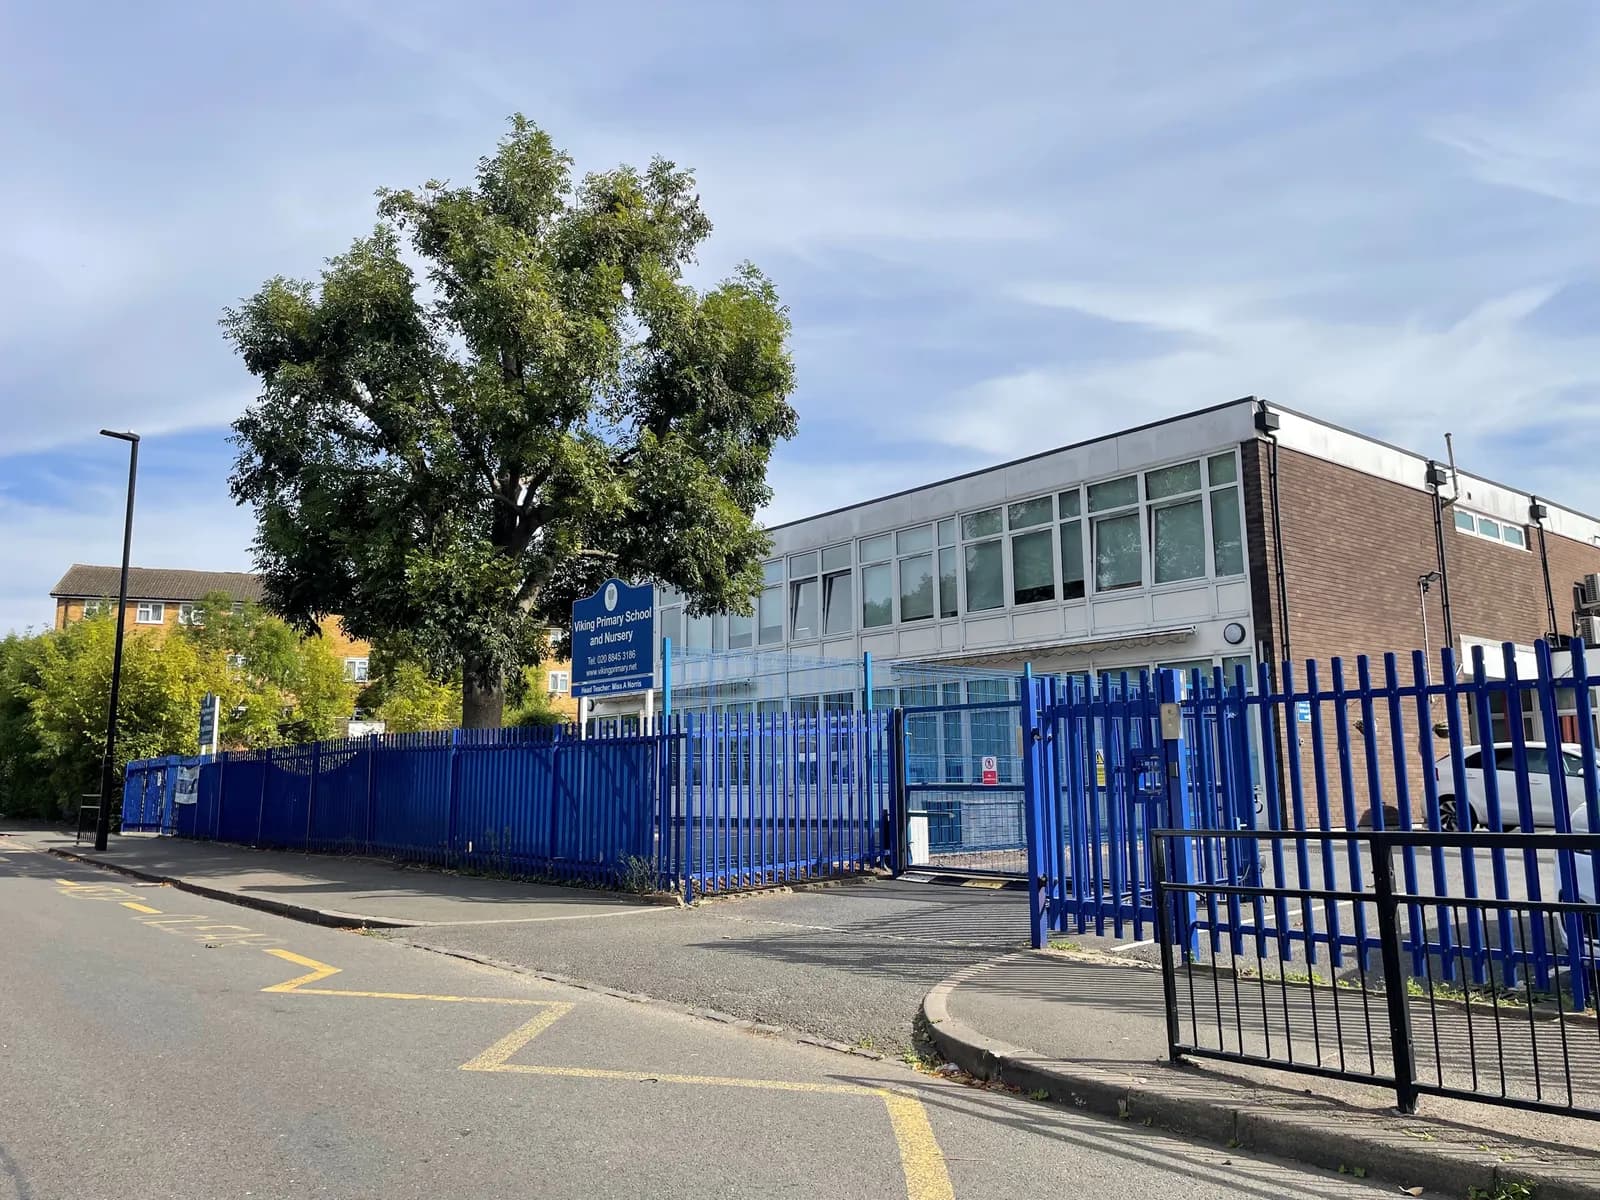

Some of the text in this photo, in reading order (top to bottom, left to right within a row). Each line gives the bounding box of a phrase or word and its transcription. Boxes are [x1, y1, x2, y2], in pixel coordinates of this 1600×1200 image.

[574, 606, 652, 632] Viking Primary School
[589, 630, 634, 646] and Nursery
[597, 654, 607, 664] 020
